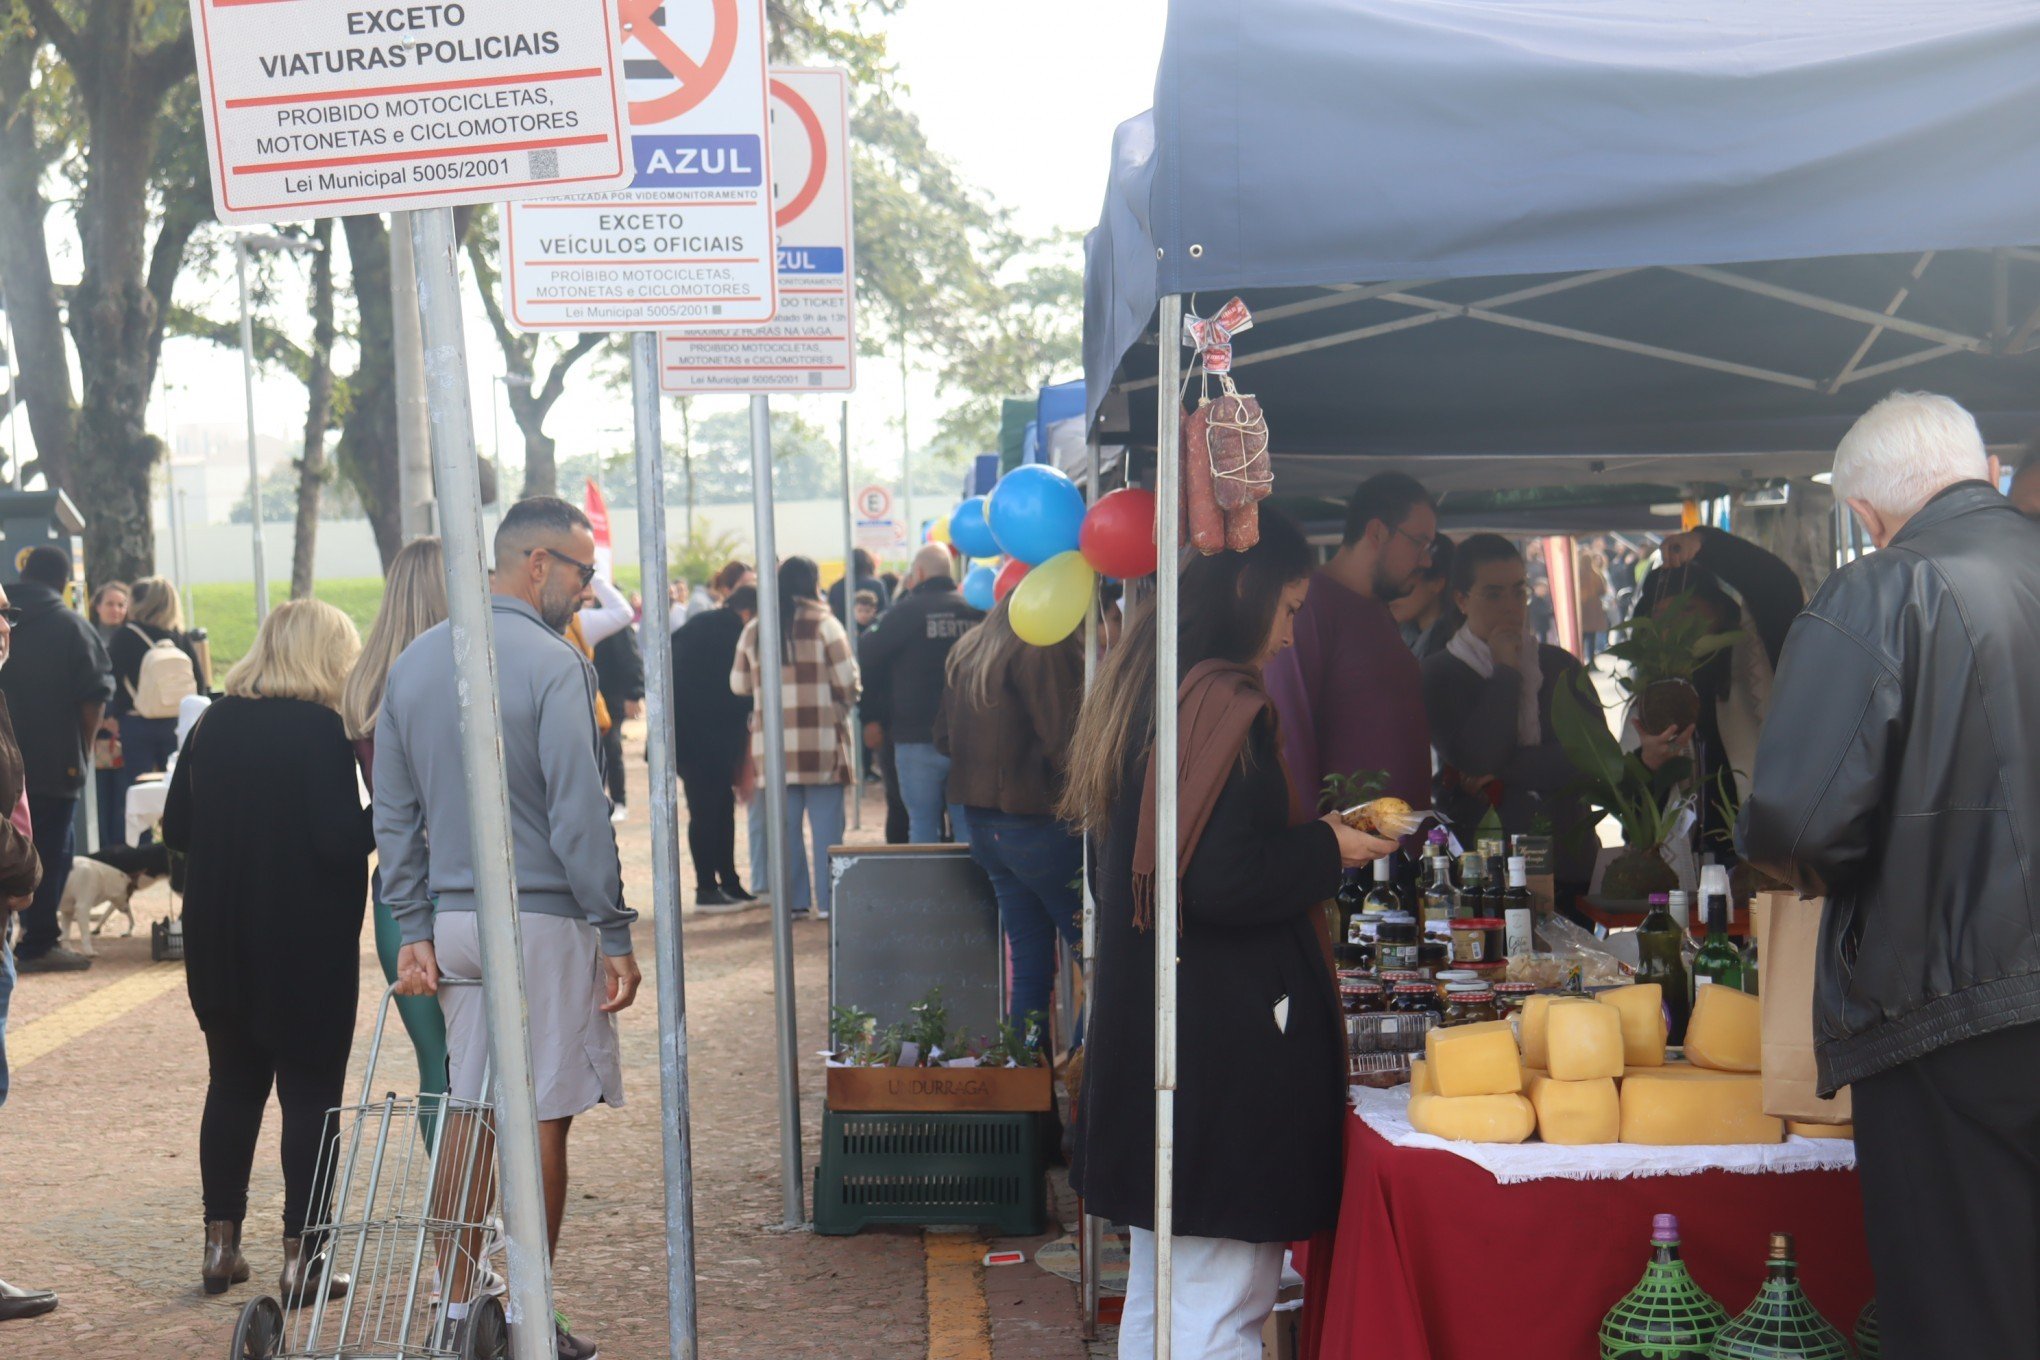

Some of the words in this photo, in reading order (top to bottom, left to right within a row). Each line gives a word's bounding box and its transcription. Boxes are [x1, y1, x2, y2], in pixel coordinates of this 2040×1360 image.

[346, 3, 466, 36] EXCETO
[259, 44, 407, 78] VIATURAS
[416, 31, 560, 65] POLICIAIS
[277, 103, 380, 127] PROIBIDO
[385, 87, 554, 117] MOTOCICLETAS,
[256, 129, 387, 155] MOTONETAS
[393, 128, 405, 144] e
[410, 111, 579, 142] CICLOMOTORES
[646, 148, 752, 175] AZUL
[284, 174, 313, 194] Lei
[319, 166, 407, 191] Municipal
[412, 158, 511, 182] 5005/2001
[611, 192, 632, 200] POR
[636, 190, 758, 200] VIDEOMONITORAMENTO
[599, 214, 683, 230] EXCETO
[540, 234, 646, 254] VEÍCULOS
[653, 236, 744, 252] OFICIAIS
[777, 252, 815, 270] ZUL
[622, 268, 735, 282] MOTOCICLETAS,
[536, 286, 622, 298] MOTONETAS
[627, 288, 635, 297] e
[638, 283, 751, 296] CICLOMOTORES
[781, 298, 800, 308] DO
[804, 297, 846, 307] TICKET
[566, 307, 584, 318] Lei
[587, 306, 643, 319] Municipal
[647, 305, 709, 317] 5005/2001
[784, 327, 799, 336] NA
[802, 327, 832, 336] VAGA
[679, 356, 742, 365] MOTONETAS
[753, 356, 833, 365] CICLOMOTORES
[706, 375, 750, 385] Municipal
[888, 1079, 990, 1096] UNDURRAGA
